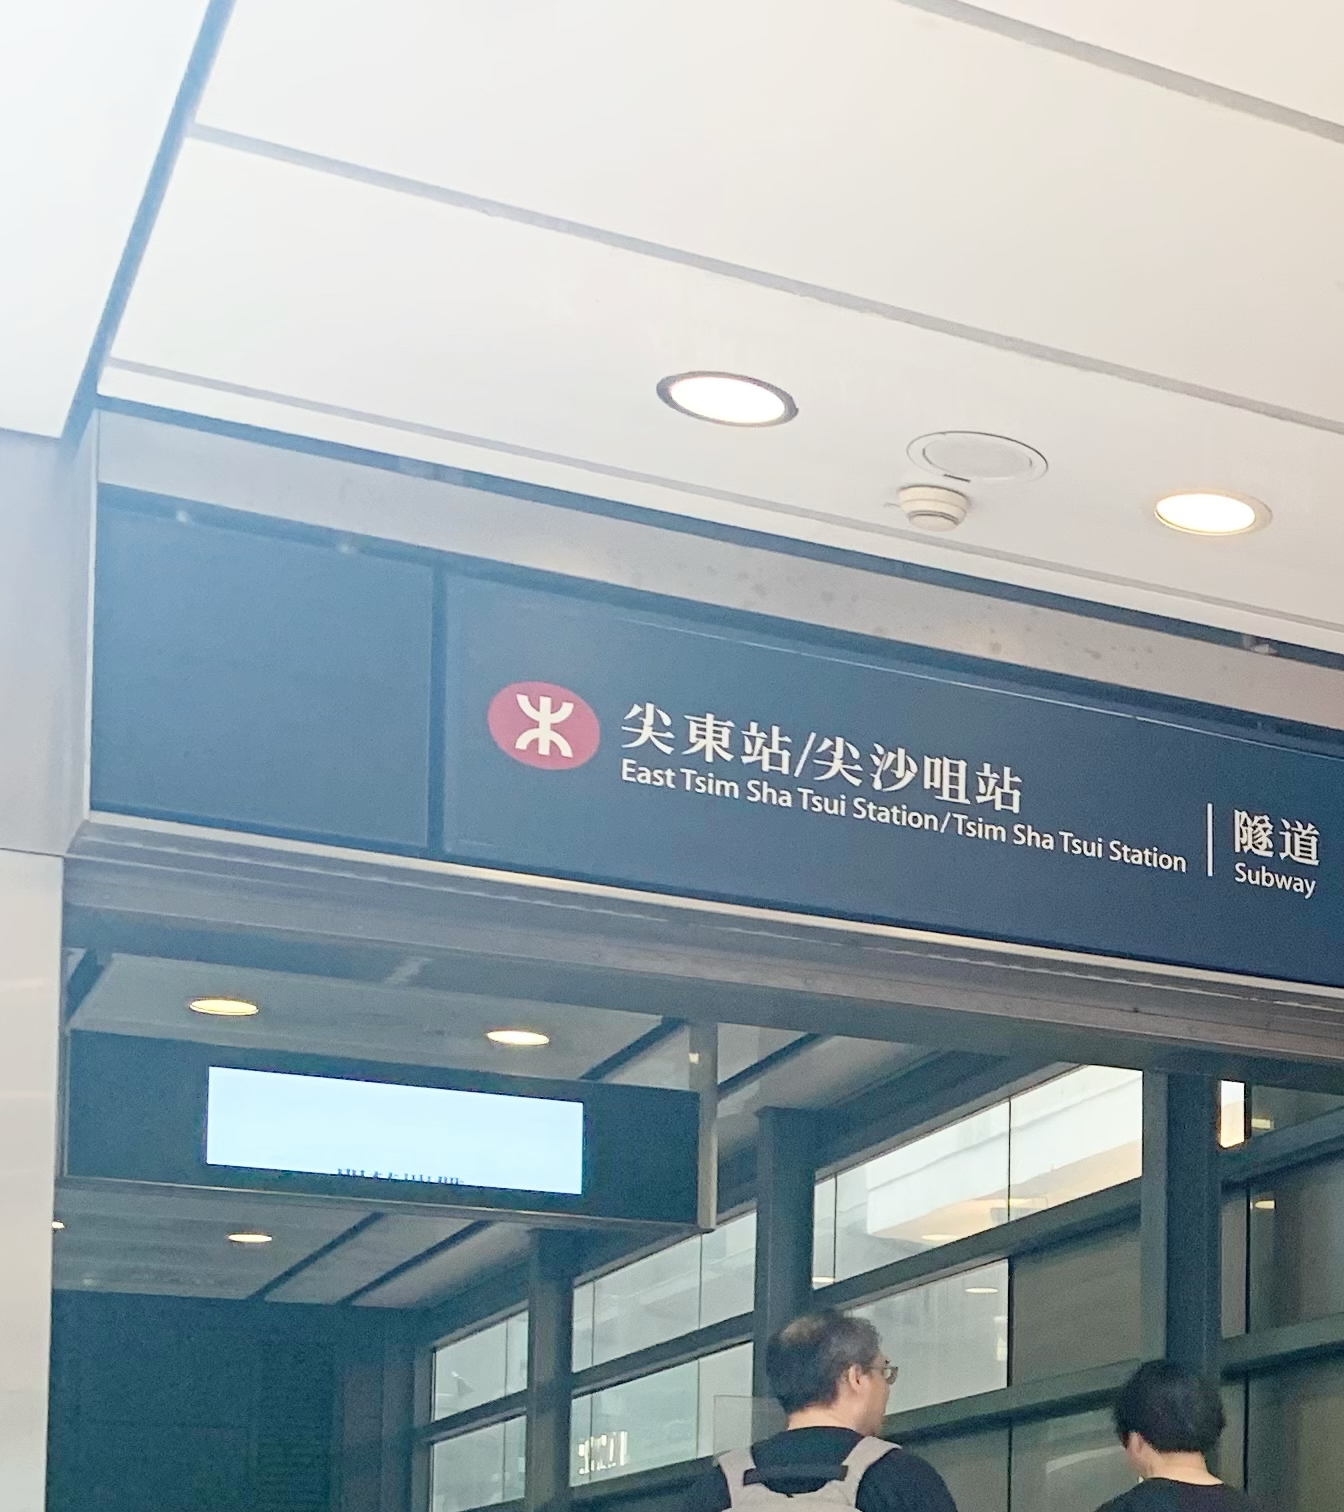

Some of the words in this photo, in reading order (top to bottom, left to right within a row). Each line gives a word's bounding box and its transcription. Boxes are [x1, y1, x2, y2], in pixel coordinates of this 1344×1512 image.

[620, 701, 1023, 814] 尖東站/尖沙咀站
[620, 757, 677, 789] East
[679, 767, 740, 799] Tsim
[746, 779, 793, 808] Sha
[797, 787, 847, 817] Tsui
[1012, 823, 1055, 851] Sha
[1058, 830, 1103, 859] Tsui
[1108, 839, 1188, 873] Station
[1233, 808, 1321, 866] 隧道
[1234, 862, 1317, 900] Subway
